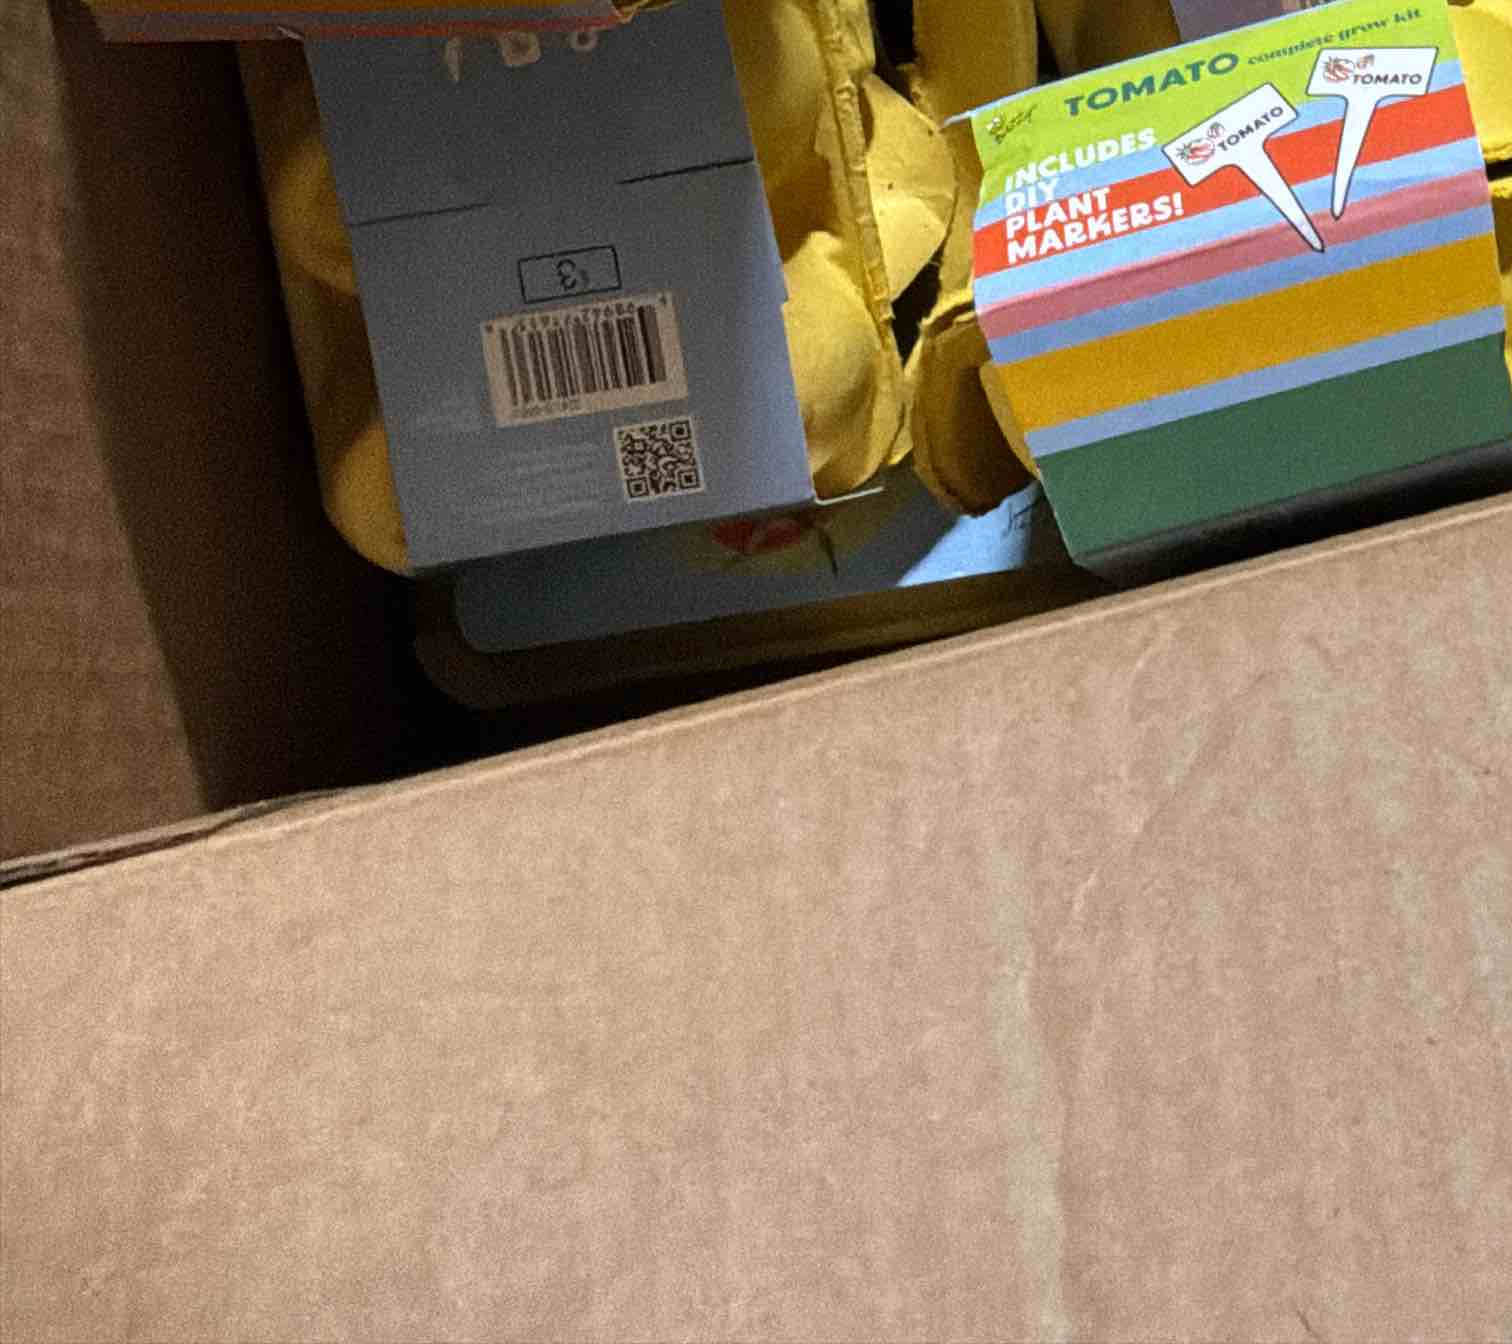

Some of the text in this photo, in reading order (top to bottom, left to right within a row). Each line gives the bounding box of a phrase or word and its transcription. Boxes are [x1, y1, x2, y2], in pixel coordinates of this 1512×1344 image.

[1062, 8, 1421, 117] TOMATO complete grow kit
[1350, 72, 1423, 87] TOMATO
[1216, 104, 1286, 154] TOMATO
[1004, 127, 1159, 193] INCLUDES
[1004, 179, 1059, 214] DIY
[1005, 187, 1111, 240] PLANT
[1006, 192, 1185, 265] MARKERS!
